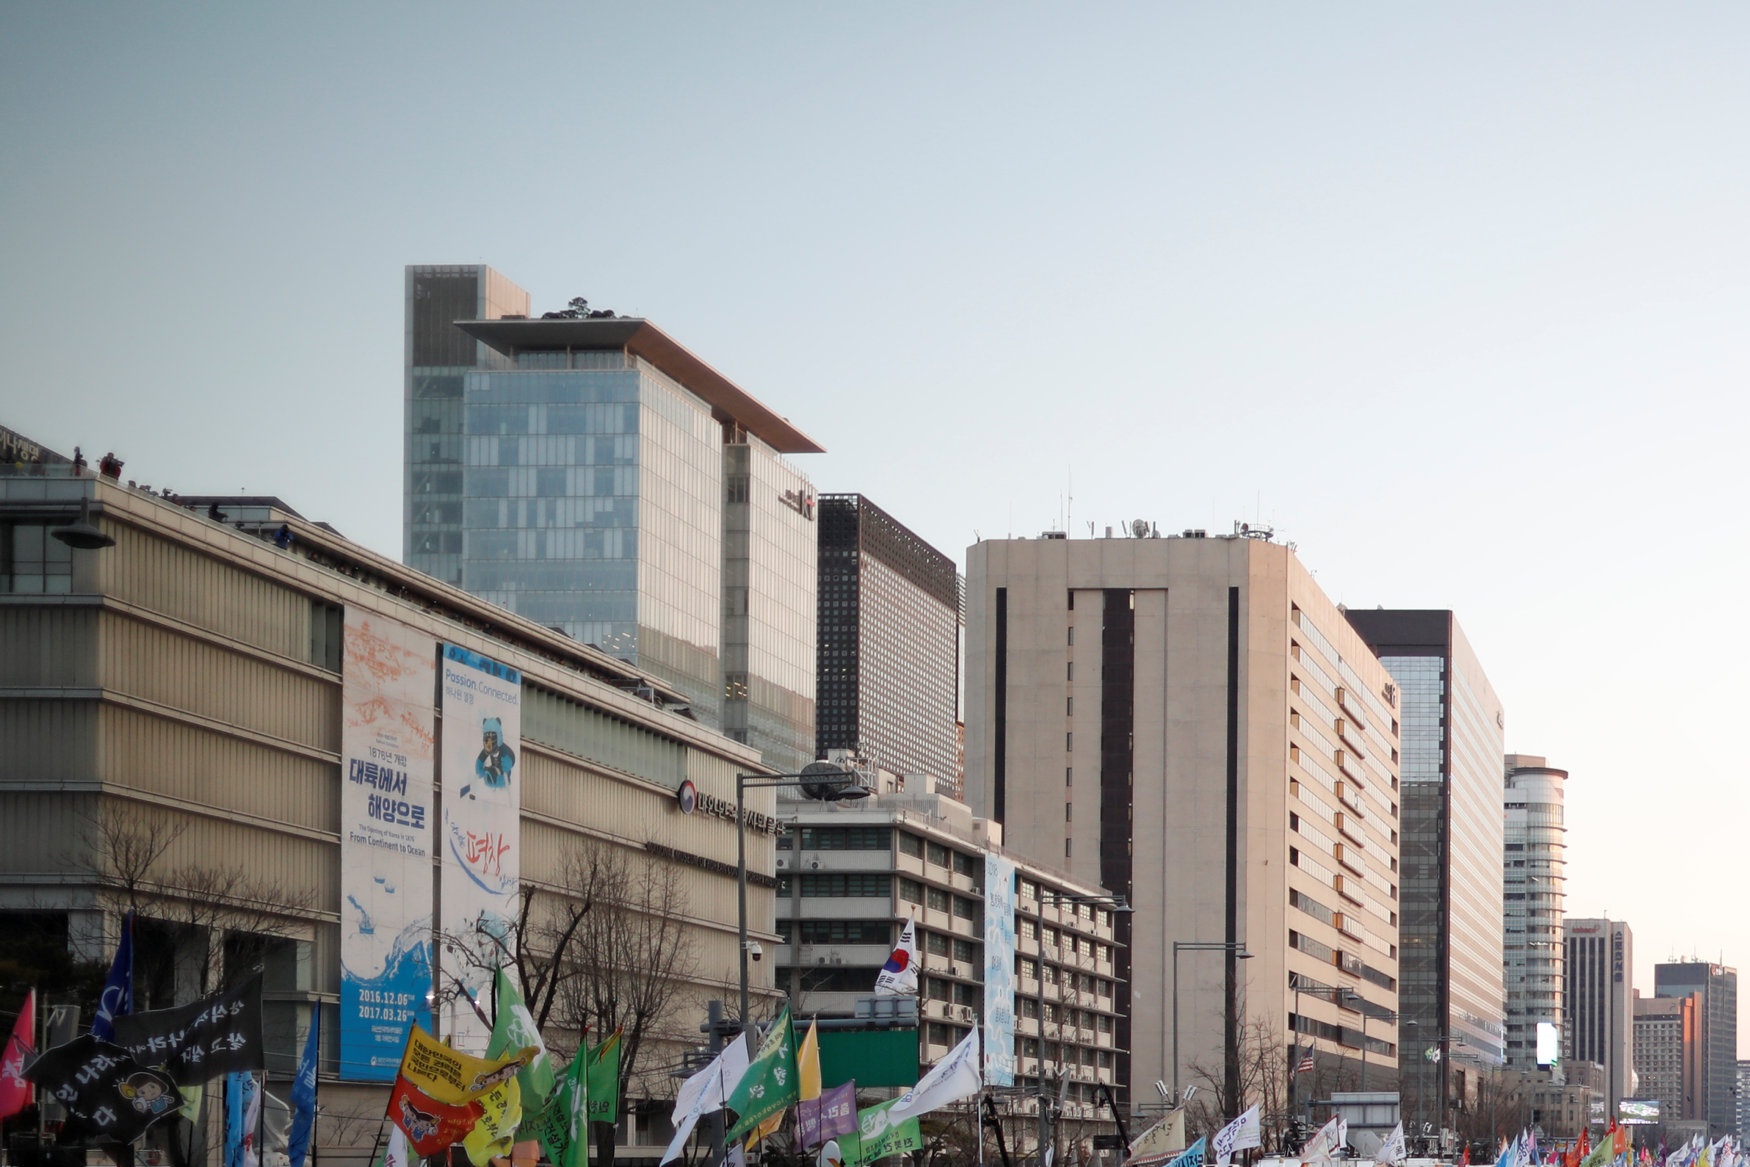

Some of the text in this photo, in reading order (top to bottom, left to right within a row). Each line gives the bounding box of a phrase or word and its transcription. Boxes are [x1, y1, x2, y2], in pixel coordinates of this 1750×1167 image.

[478, 681, 518, 705] Connected.
[349, 759, 407, 796] 대륙에서
[368, 793, 425, 829] 해양으로
[350, 831, 426, 857] From Continent to Ocean
[358, 989, 408, 1006] 2016.12.06
[358, 1005, 407, 1022] 2017.03.26
